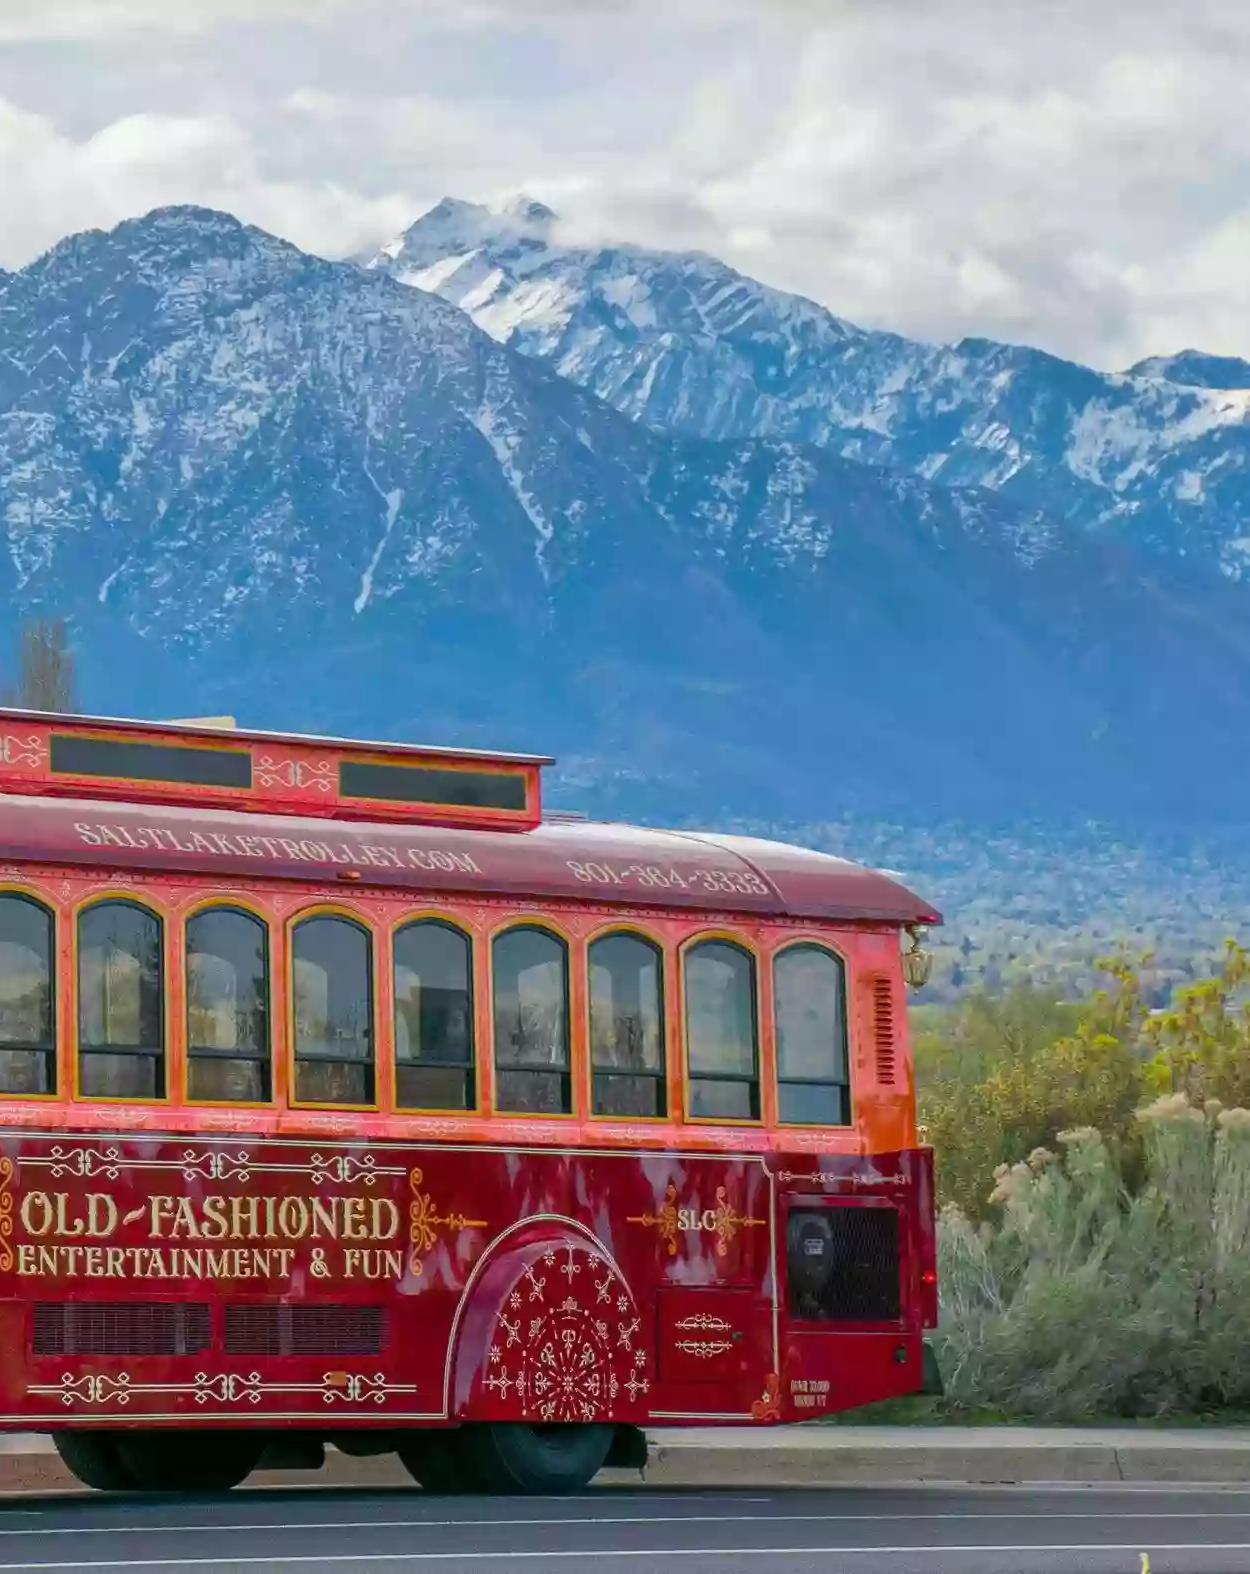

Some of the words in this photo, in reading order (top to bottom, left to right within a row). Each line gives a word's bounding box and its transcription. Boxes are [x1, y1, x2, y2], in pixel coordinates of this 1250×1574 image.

[73, 822, 482, 874] SALTLAKETROLLEY.COM
[566, 861, 770, 894] 801-364-3333
[677, 1209, 716, 1231] SLC
[16, 1244, 295, 1279] ENTERTAINMENT
[310, 1248, 332, 1278] &
[343, 1248, 403, 1279] FUN
